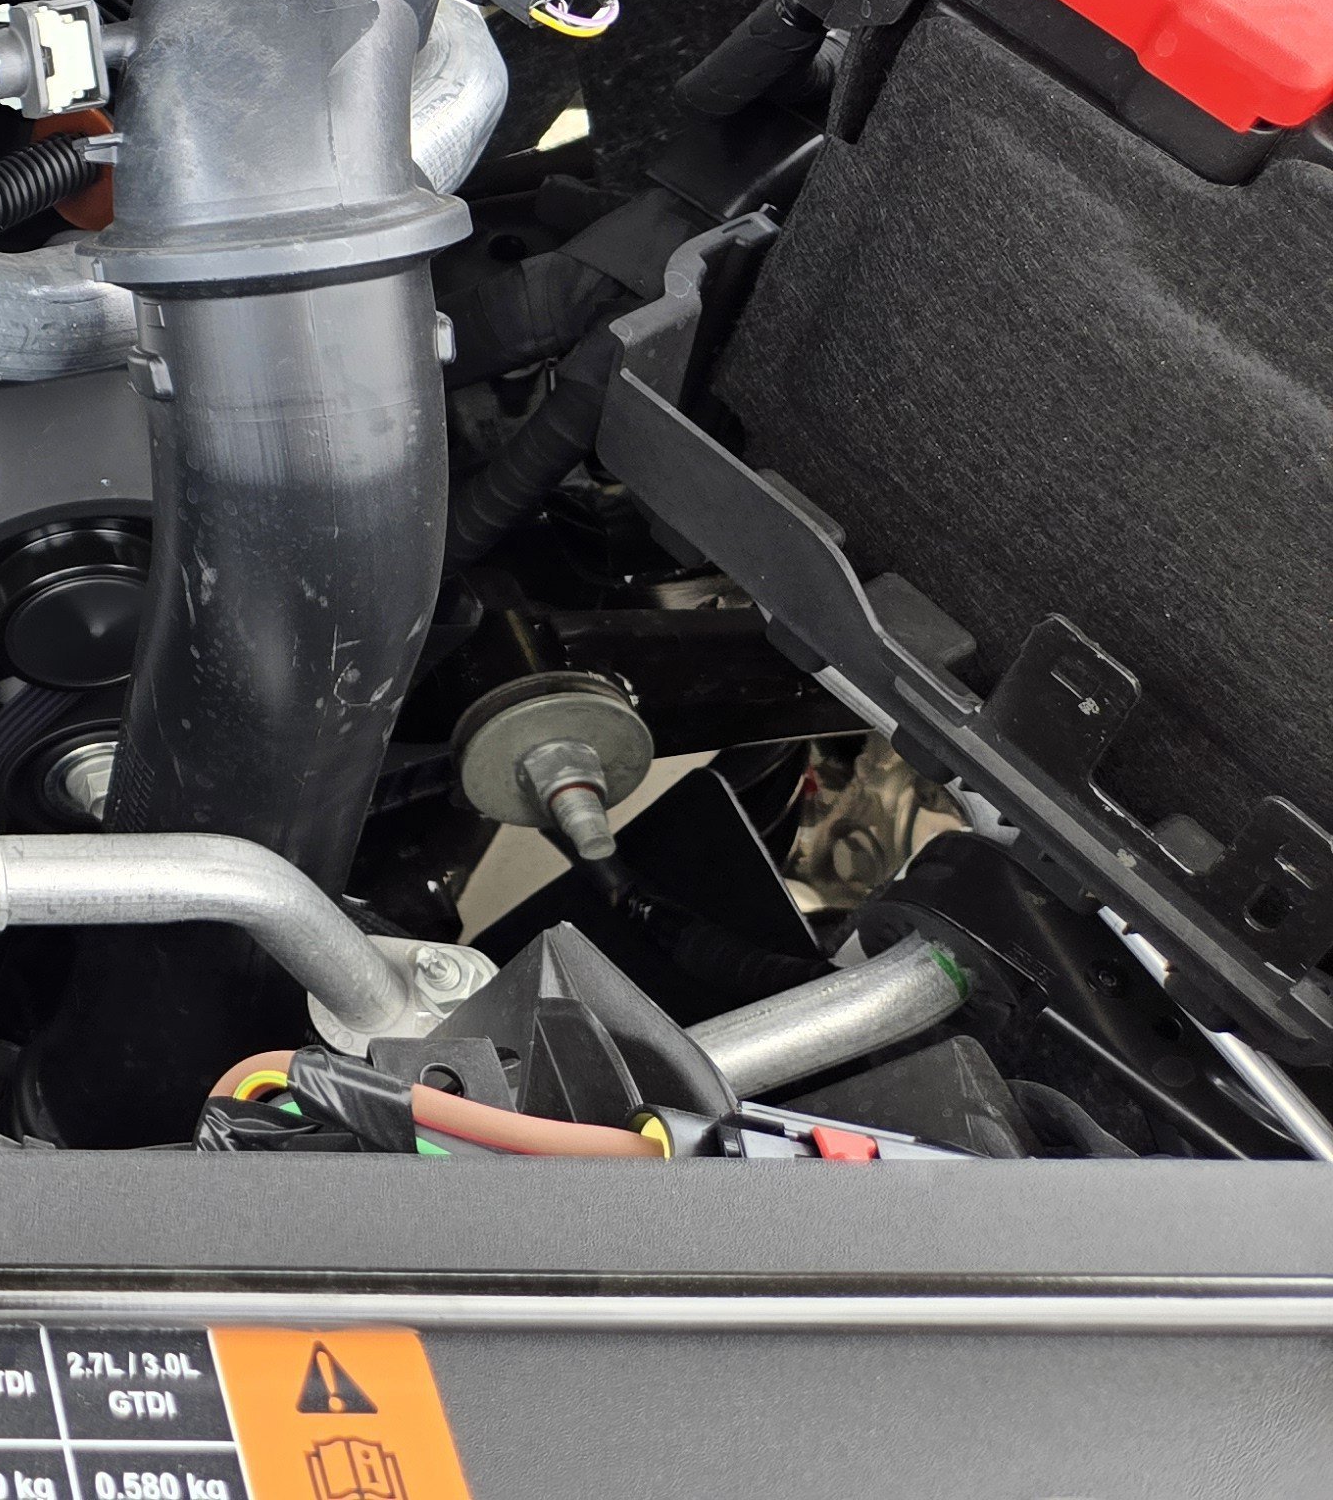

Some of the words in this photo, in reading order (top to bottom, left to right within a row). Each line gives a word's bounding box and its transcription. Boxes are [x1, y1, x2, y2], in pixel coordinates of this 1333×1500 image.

[67, 1351, 126, 1378] 2.7L
[142, 1352, 203, 1379] 3.0L
[108, 1390, 178, 1420] GTDI
[14, 1471, 56, 1500] kg
[94, 1471, 181, 1500] 0.580
[186, 1472, 229, 1500] kg
